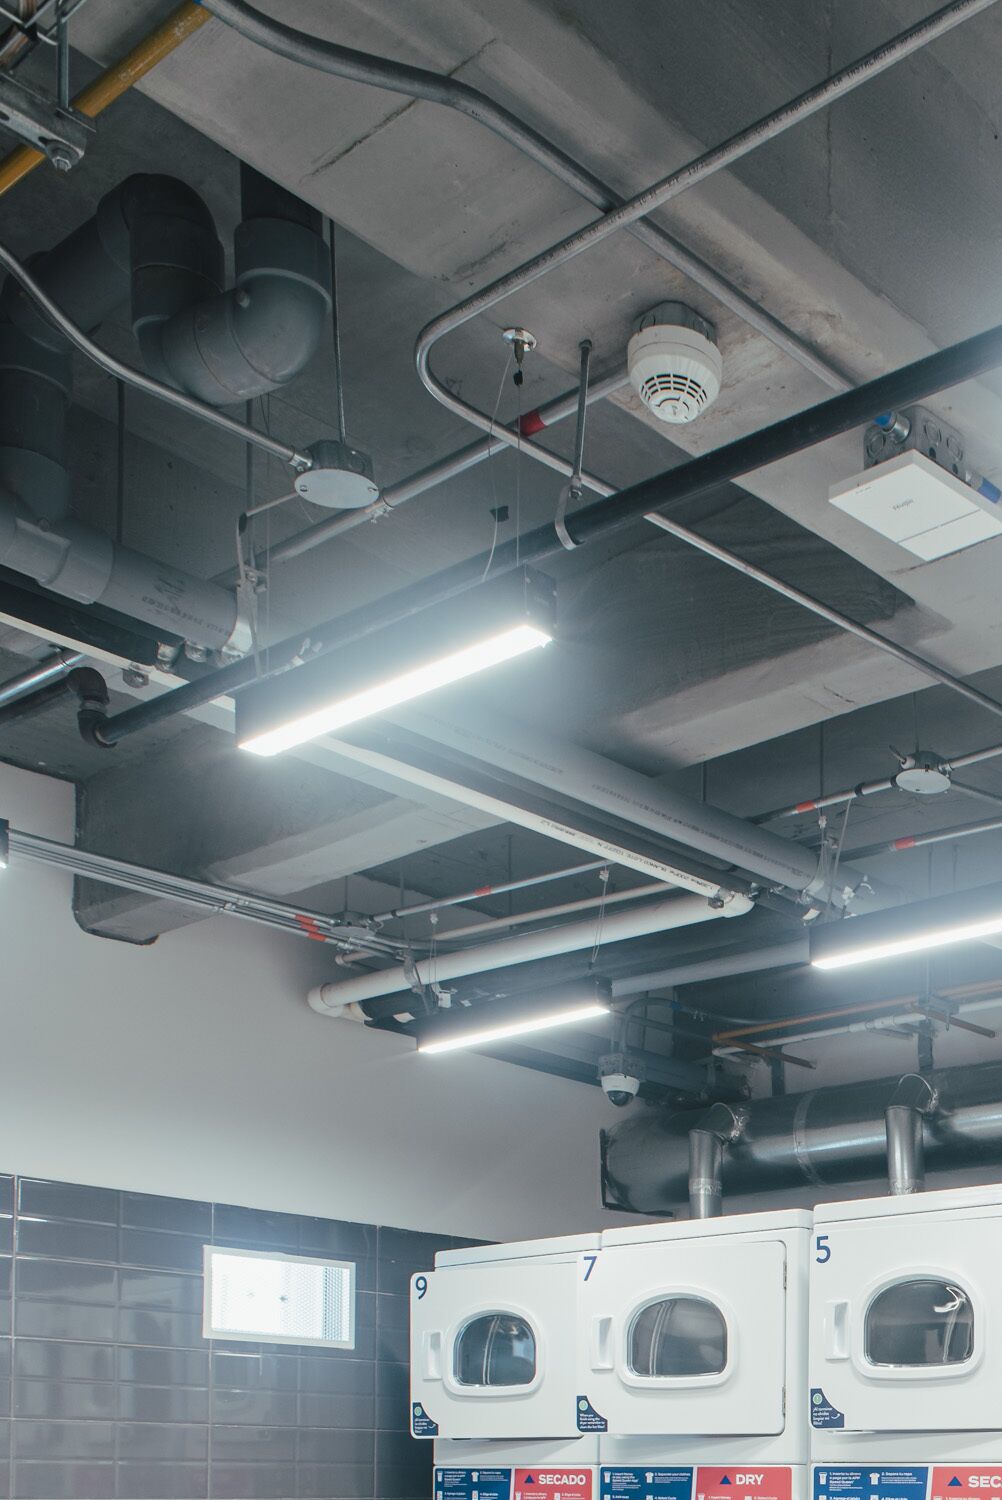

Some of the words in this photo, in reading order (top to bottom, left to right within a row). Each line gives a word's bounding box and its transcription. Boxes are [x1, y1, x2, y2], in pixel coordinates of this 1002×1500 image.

[816, 1235, 831, 1264] 5
[583, 1256, 598, 1282] 7
[415, 1276, 428, 1300] 9
[538, 1474, 586, 1485] SECADO
[735, 1473, 764, 1485] DRY
